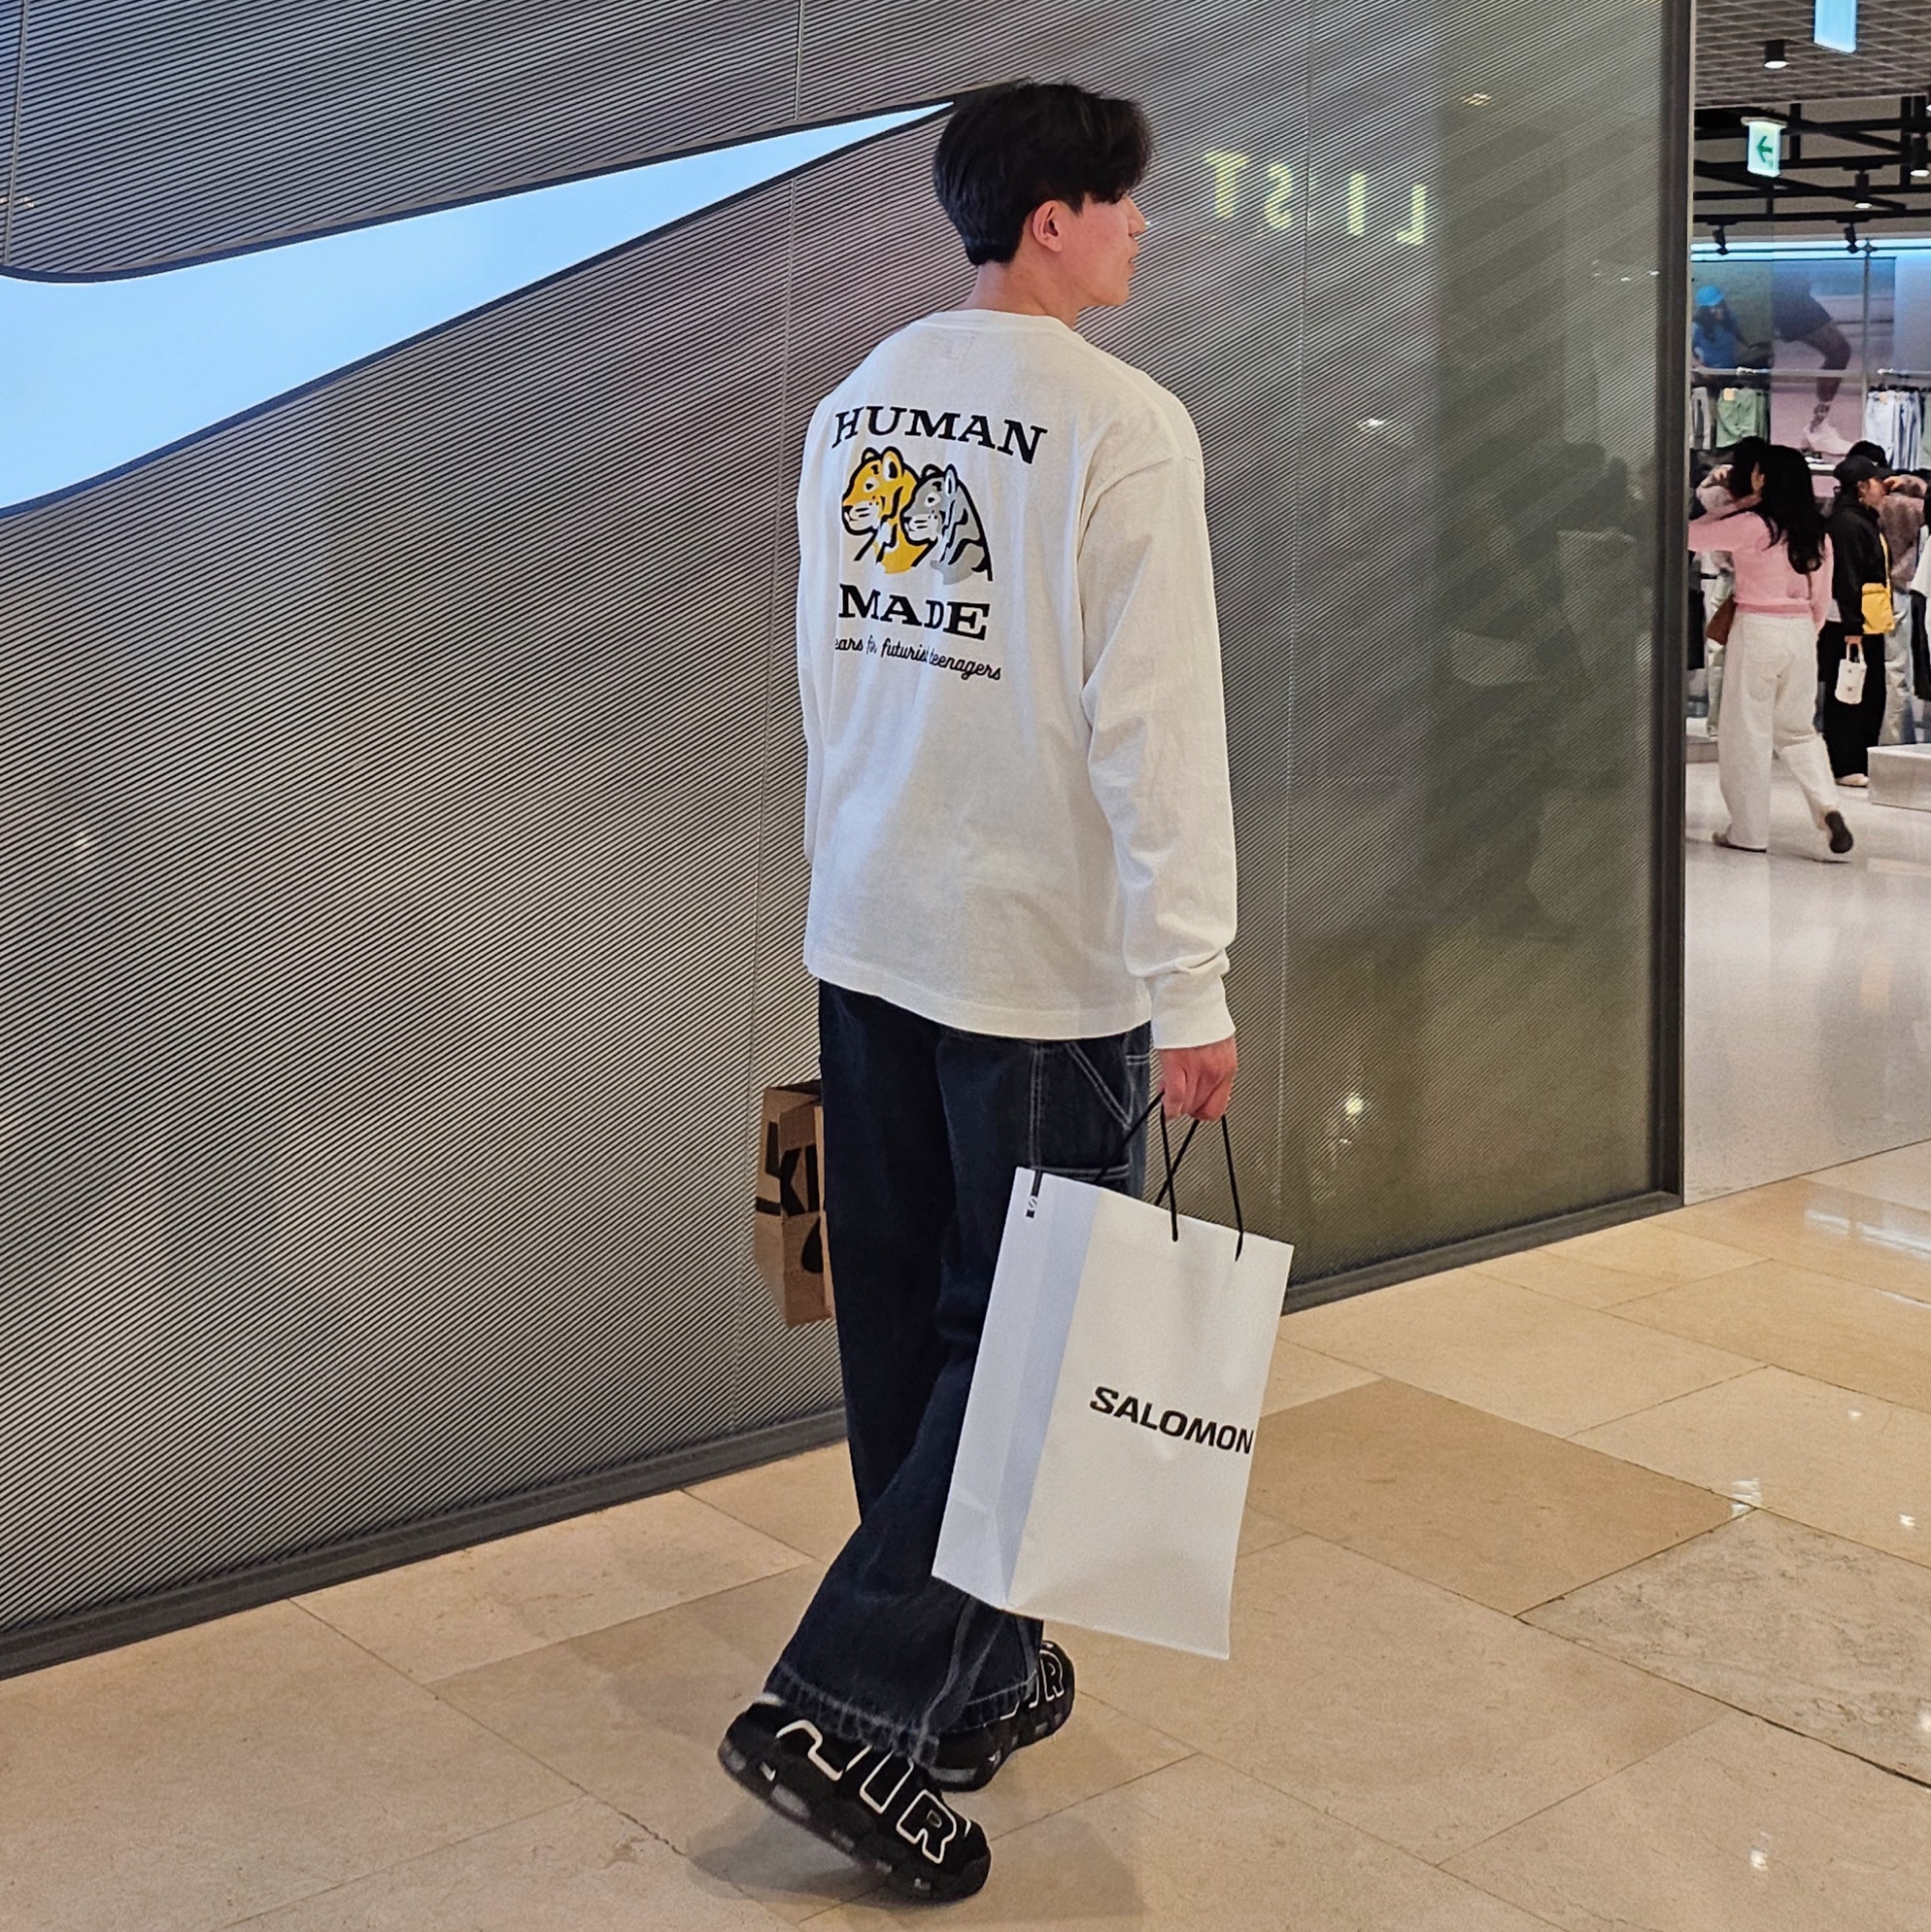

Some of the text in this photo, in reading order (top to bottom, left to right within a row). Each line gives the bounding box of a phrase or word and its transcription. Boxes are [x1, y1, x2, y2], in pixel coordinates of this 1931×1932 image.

[831, 405, 1048, 464] HUMAN
[838, 583, 991, 641] MADE
[834, 637, 864, 652] ears
[1089, 1386, 1254, 1455] SALOMON
